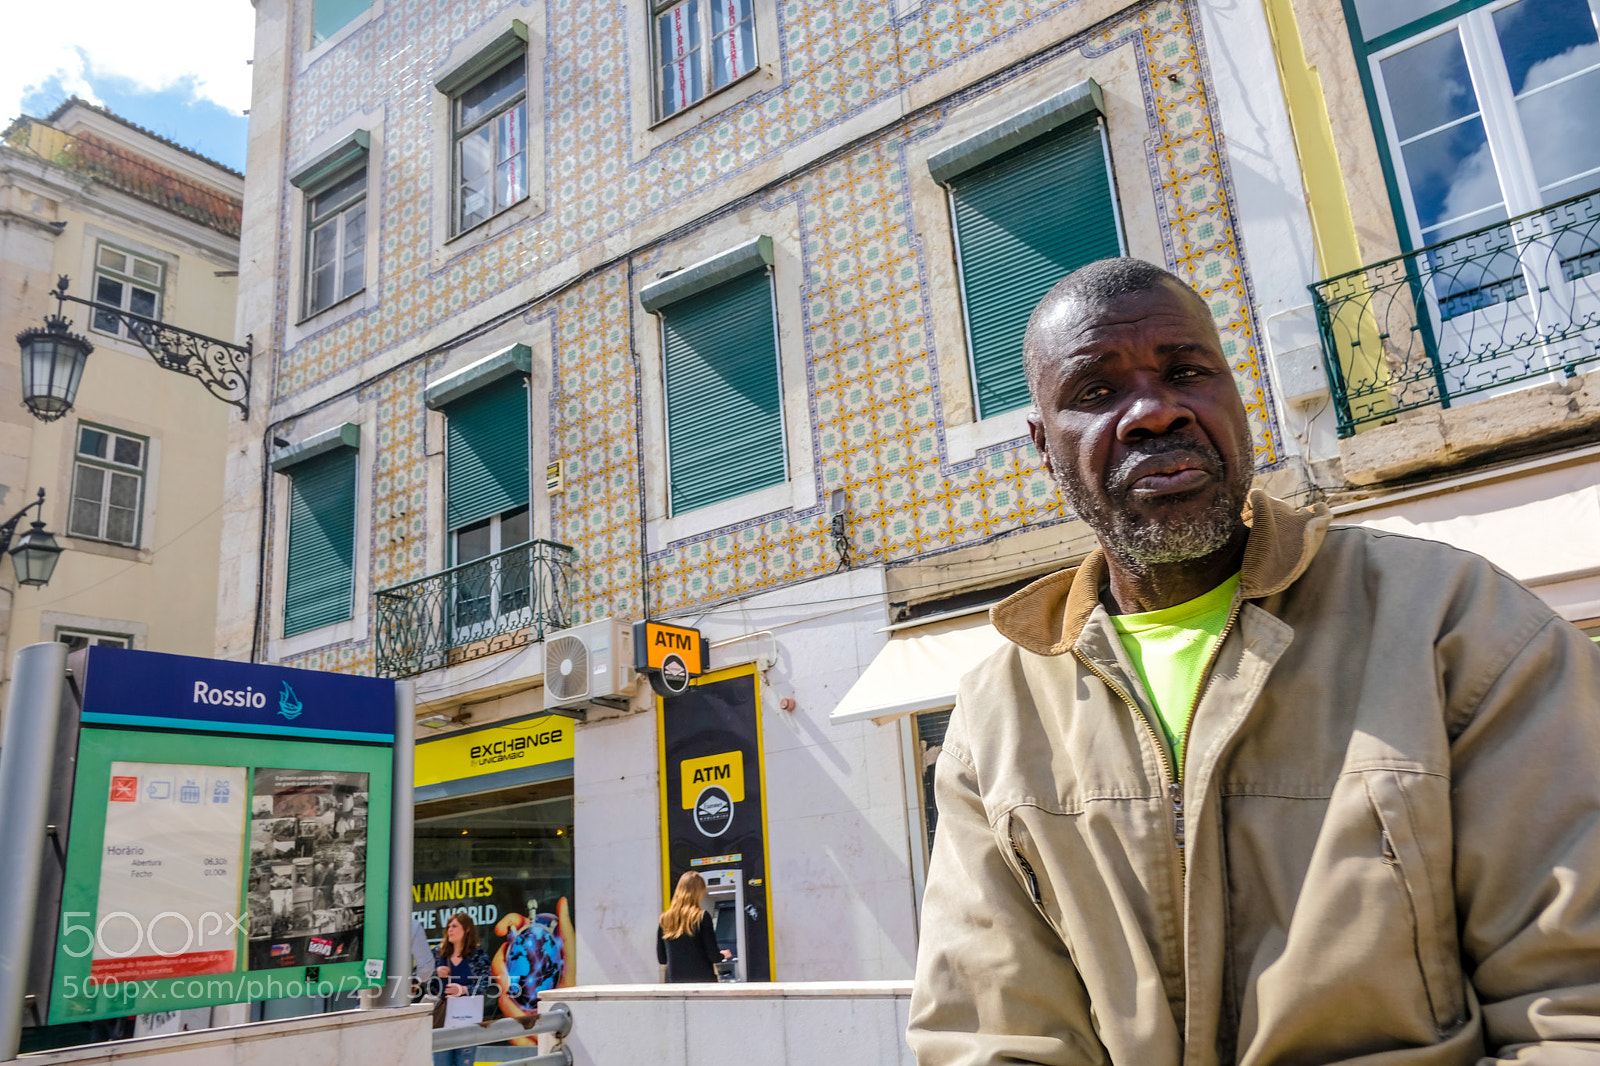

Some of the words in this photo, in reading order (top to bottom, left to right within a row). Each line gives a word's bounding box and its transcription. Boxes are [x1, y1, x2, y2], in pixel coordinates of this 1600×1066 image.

[655, 630, 692, 651] ATM
[193, 680, 267, 709] Rossio
[693, 763, 731, 784] ATM
[107, 845, 145, 856] Horário
[424, 876, 494, 903] MINUTES
